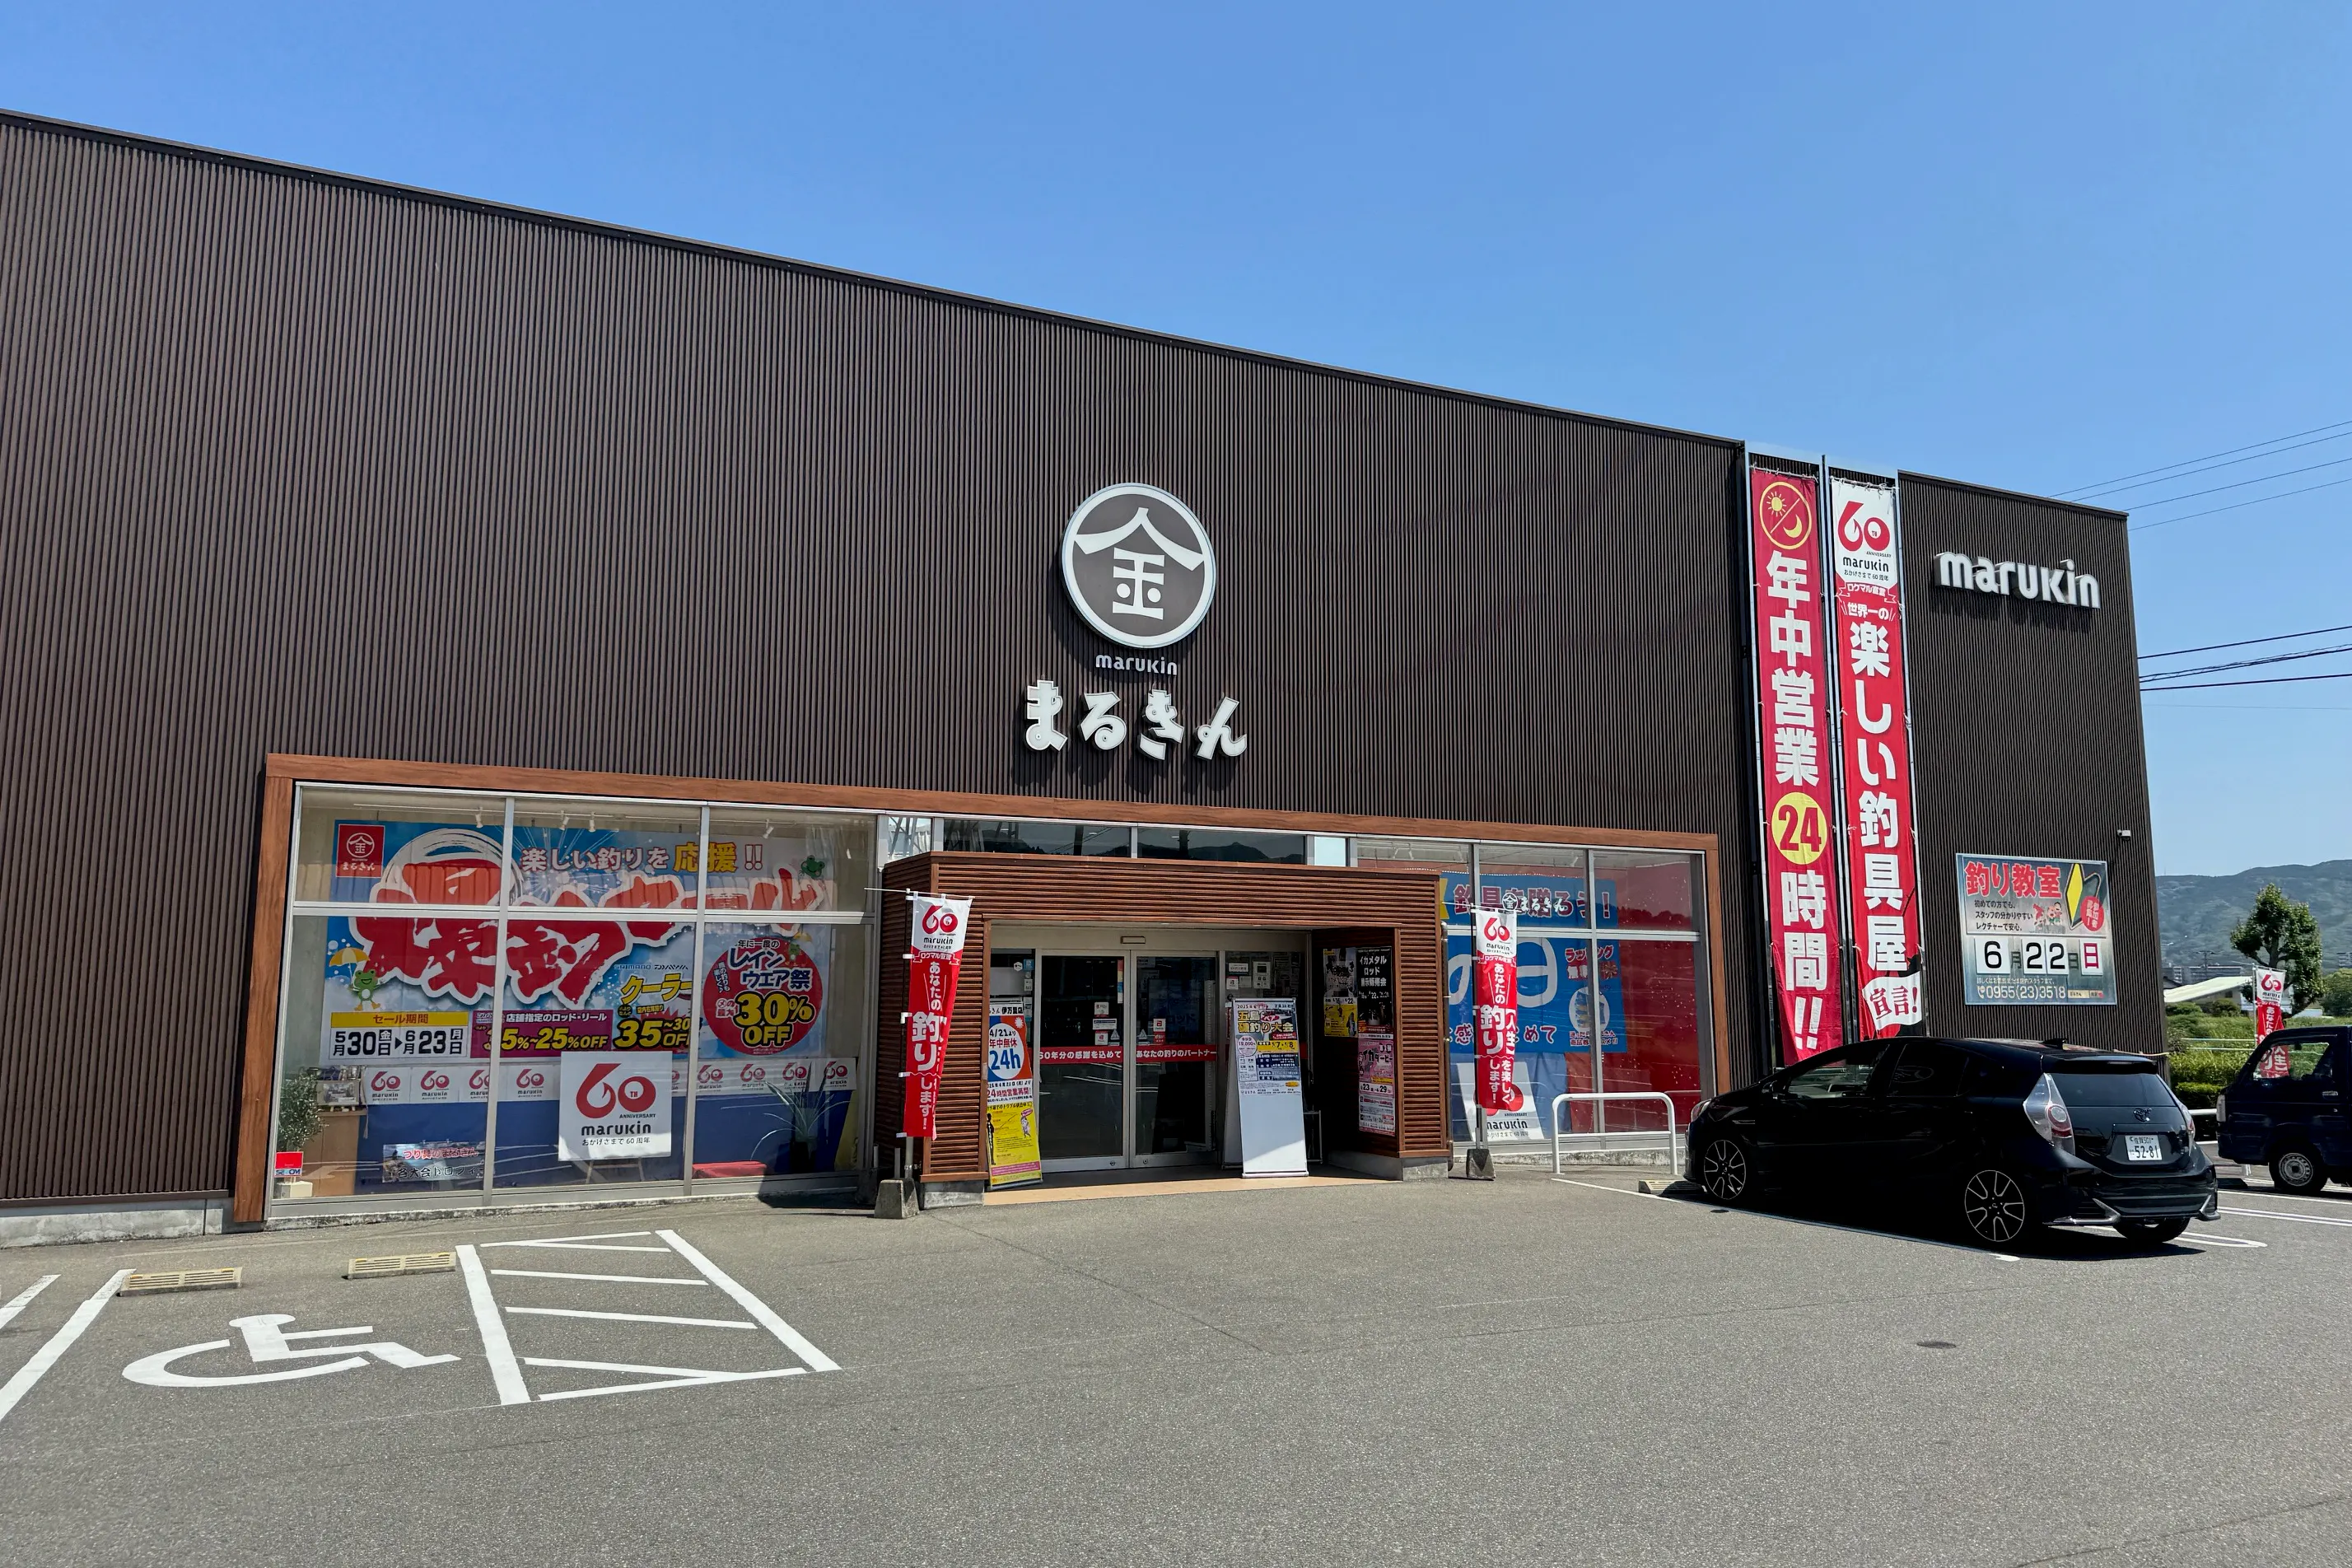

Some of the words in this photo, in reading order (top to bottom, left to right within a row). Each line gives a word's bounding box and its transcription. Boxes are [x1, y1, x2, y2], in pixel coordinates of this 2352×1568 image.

[1838, 501, 1890, 552] 60
[1842, 556, 1889, 572] marukin
[1934, 551, 2100, 609] marukin
[1847, 602, 1889, 622] 世界一の
[1095, 654, 1178, 676] marukin
[1026, 679, 1248, 760] まるきん
[1850, 622, 1908, 972] 楽しい釣具屋
[1964, 861, 2062, 898] 釣り教室
[922, 904, 959, 935] 60
[1975, 911, 2033, 920] スタッフの分かりやすい
[1483, 917, 1510, 941] 60
[730, 948, 784, 968] レイン
[1360, 955, 1387, 965] イカメタル
[1984, 940, 2002, 968] 6
[2025, 942, 2065, 969] 22
[1364, 967, 1380, 976] ロッド
[1493, 963, 1506, 1005] あなたの
[620, 973, 693, 1005] クーラー
[929, 961, 941, 1010] あなたの
[1986, 985, 2066, 1000] 0955(23)3518
[373, 1014, 428, 1024] セール期間
[735, 992, 814, 1027] 30%
[744, 1024, 791, 1045] OFF
[912, 1011, 940, 1071] 釣り
[1480, 1004, 1506, 1055] 釣り
[348, 1031, 376, 1056] 30
[418, 1030, 446, 1054] 23
[989, 1038, 1018, 1048] 年中無休
[988, 1048, 1021, 1071] 24h
[576, 1063, 656, 1118] 60
[581, 1121, 651, 1136] marukin
